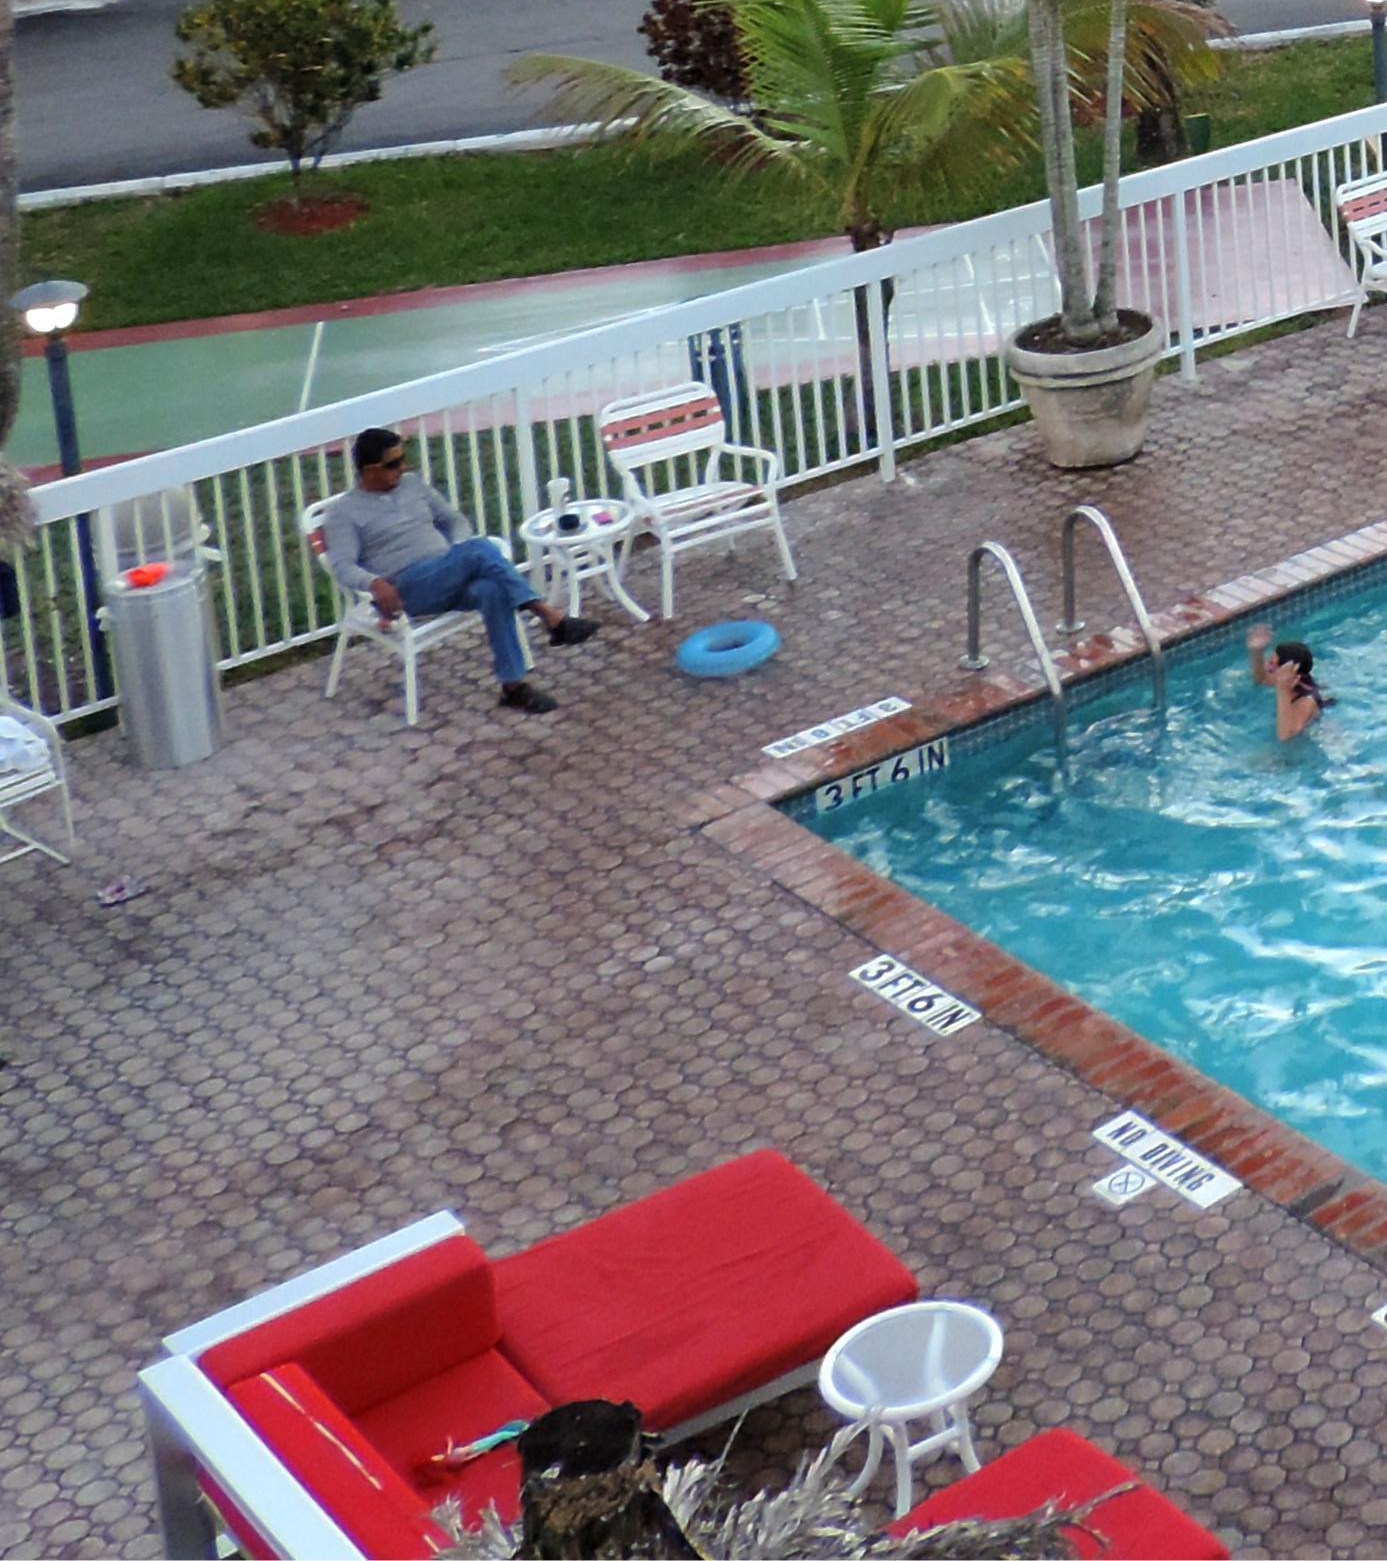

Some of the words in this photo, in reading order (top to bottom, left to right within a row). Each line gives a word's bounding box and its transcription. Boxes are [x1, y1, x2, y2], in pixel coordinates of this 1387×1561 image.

[825, 784, 842, 811] 3
[852, 766, 880, 798] FT
[891, 757, 909, 773] 6
[918, 741, 946, 775] IN
[859, 960, 896, 982] 3
[906, 992, 944, 1013] 6
[1107, 1121, 1148, 1146] NO
[1139, 1143, 1216, 1192] DIVING
